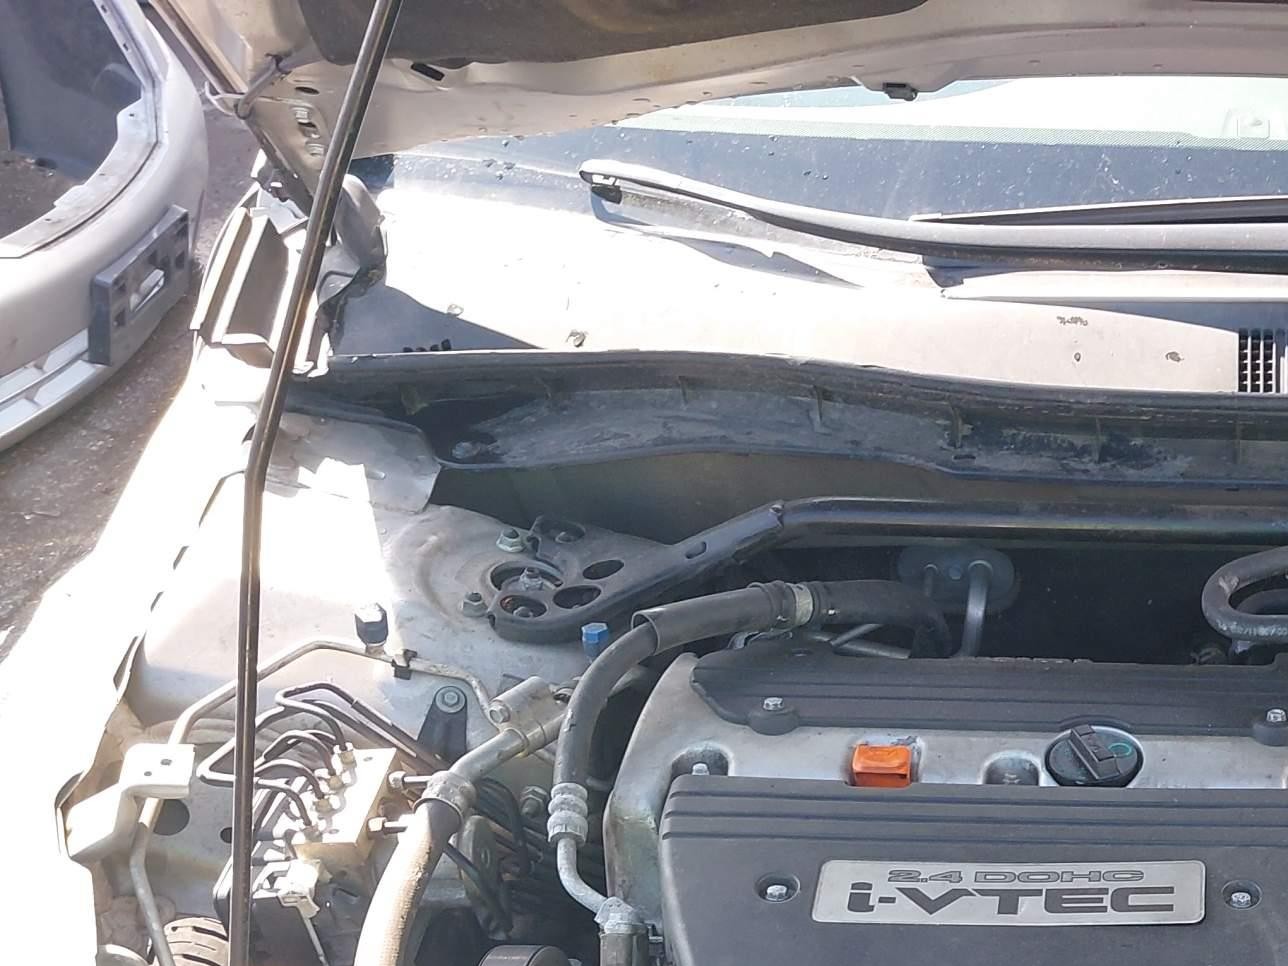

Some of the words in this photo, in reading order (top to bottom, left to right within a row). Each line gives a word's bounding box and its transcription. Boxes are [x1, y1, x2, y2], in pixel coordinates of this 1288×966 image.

[887, 869, 963, 884] 2.4
[974, 869, 1145, 883] DOHC
[847, 881, 1175, 916] i-VTEC
